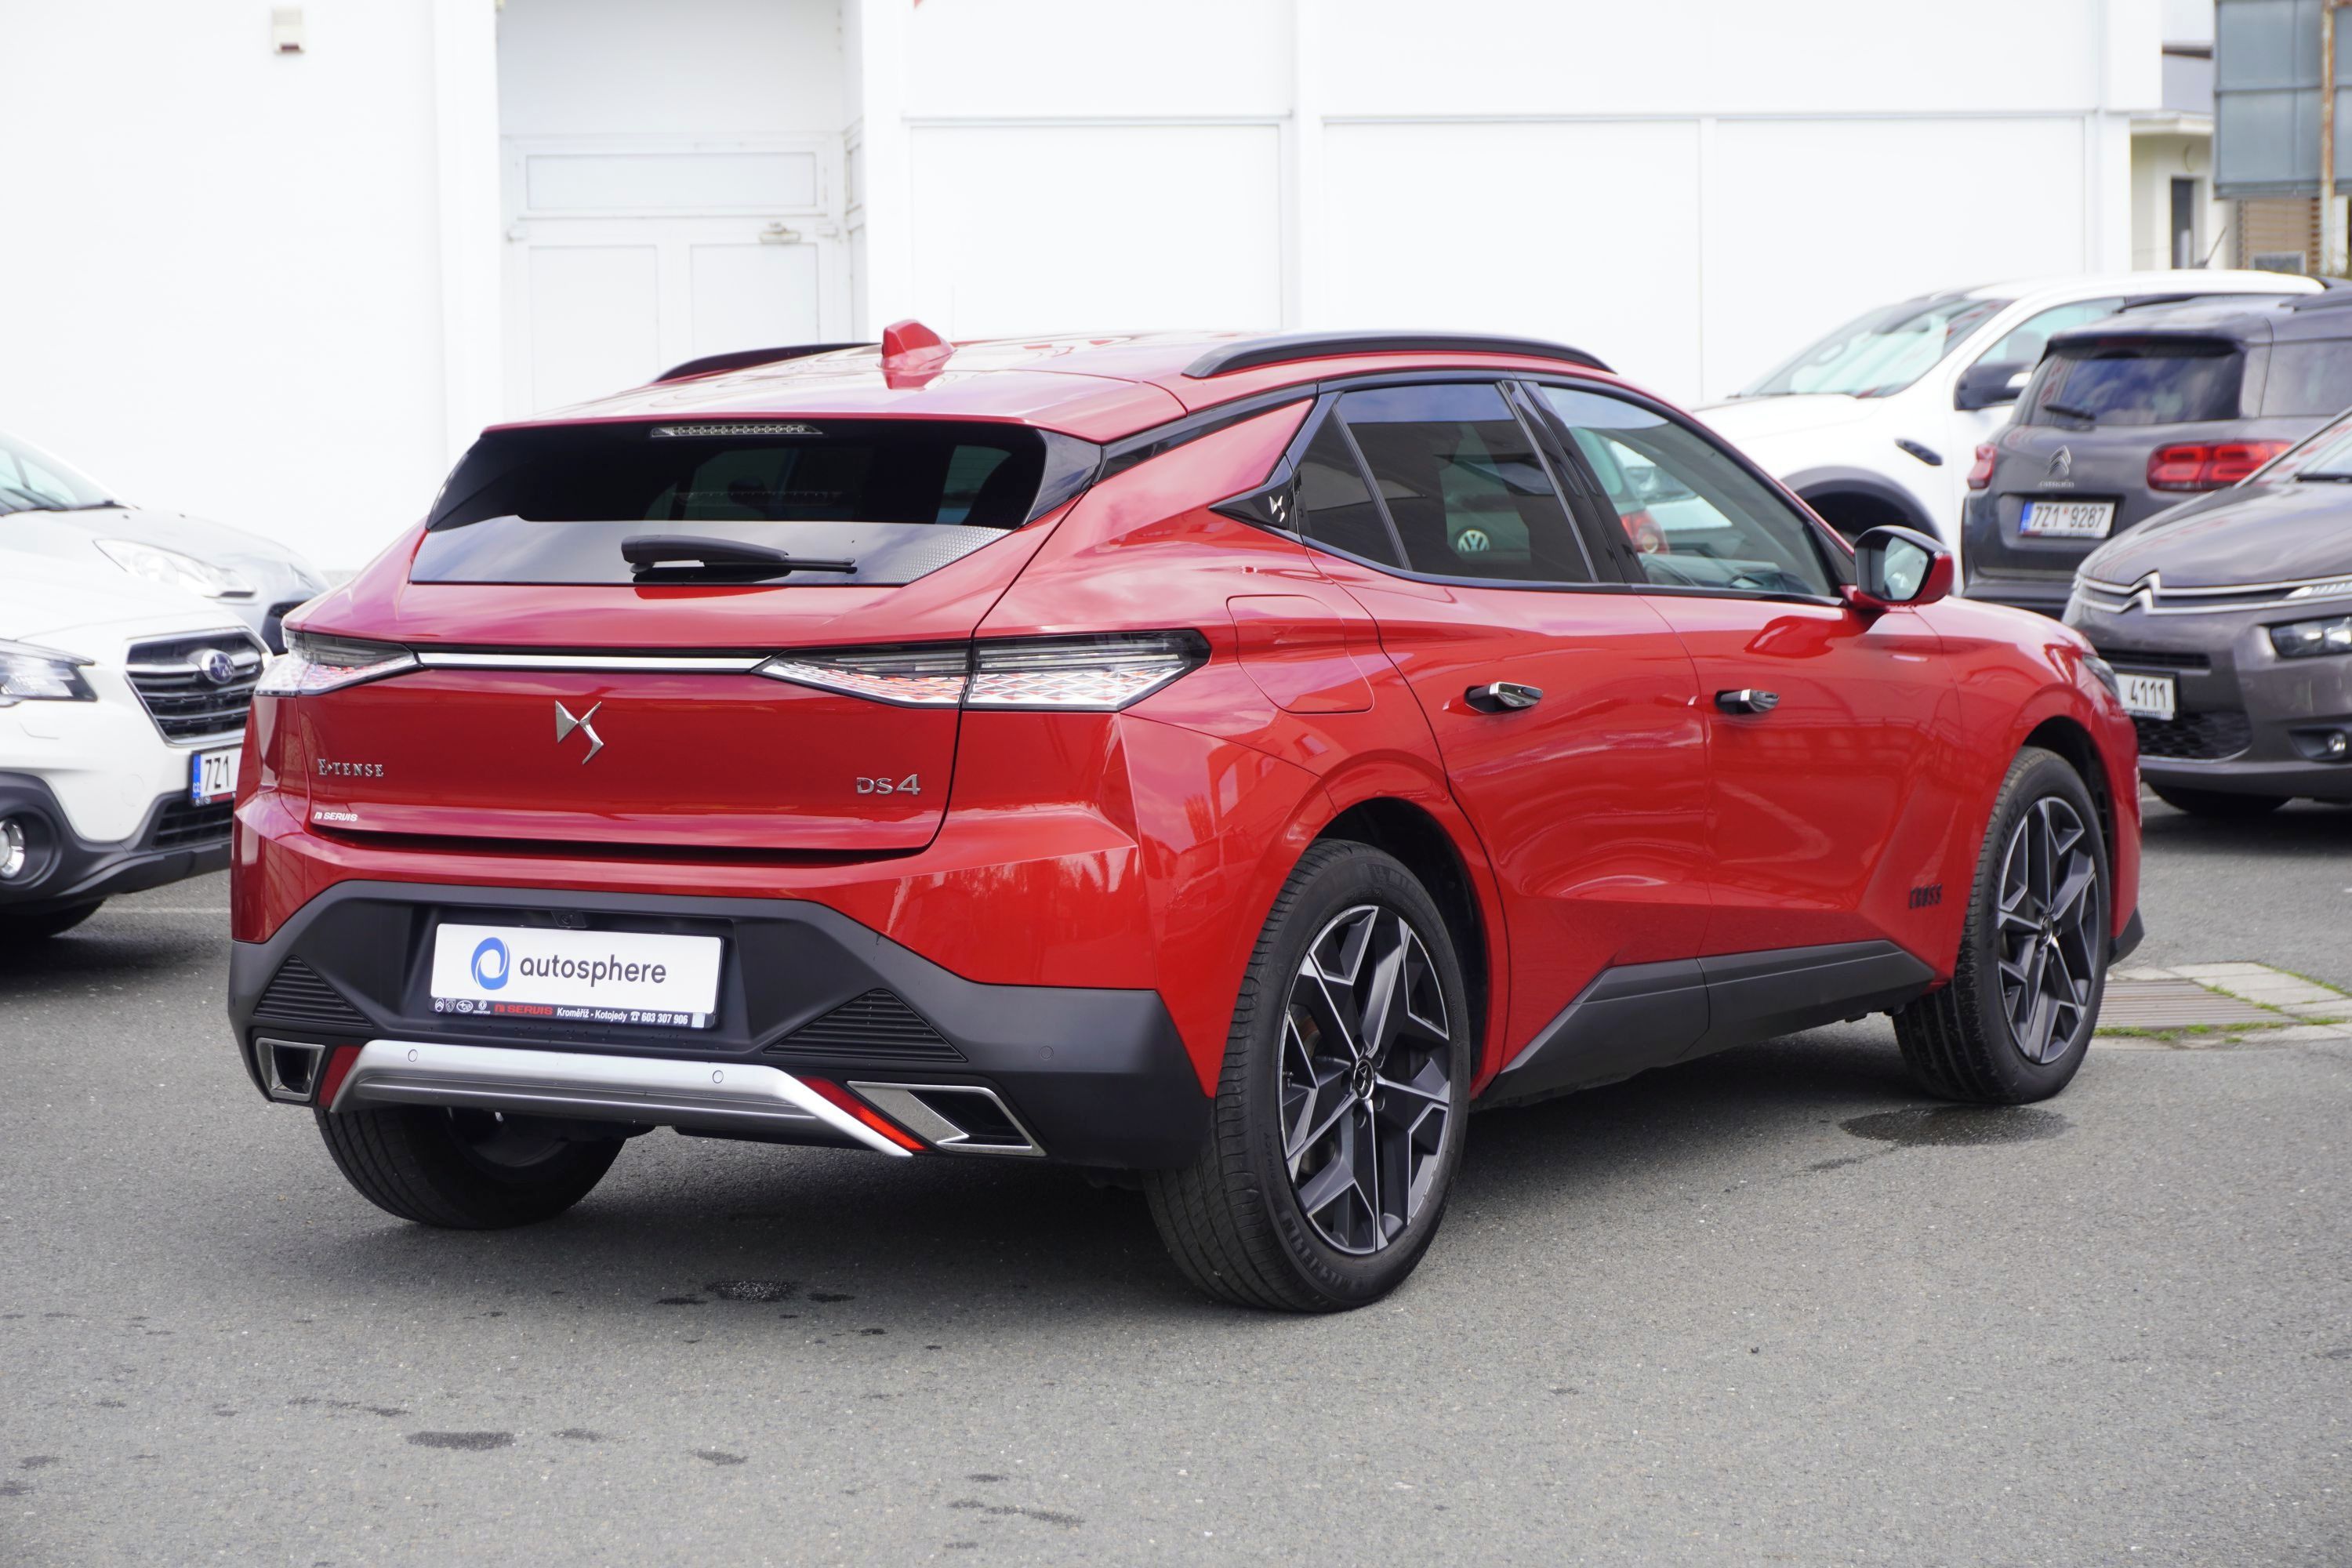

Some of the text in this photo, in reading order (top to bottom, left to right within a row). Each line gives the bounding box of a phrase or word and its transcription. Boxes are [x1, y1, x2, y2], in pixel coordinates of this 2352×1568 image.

[2033, 505, 2060, 528] 7Z1
[2070, 506, 2106, 528] 9287
[2131, 678, 2166, 710] 4111
[205, 754, 230, 792] 7Z1
[323, 811, 358, 822] SERVIS
[520, 953, 666, 987] autosphere
[507, 1004, 553, 1015] SERVIS
[557, 1007, 590, 1018] Kroměříž
[595, 1010, 627, 1023] Kotojedy
[641, 1012, 656, 1022] 603
[658, 1014, 672, 1024] 307
[673, 1015, 688, 1025] 906
